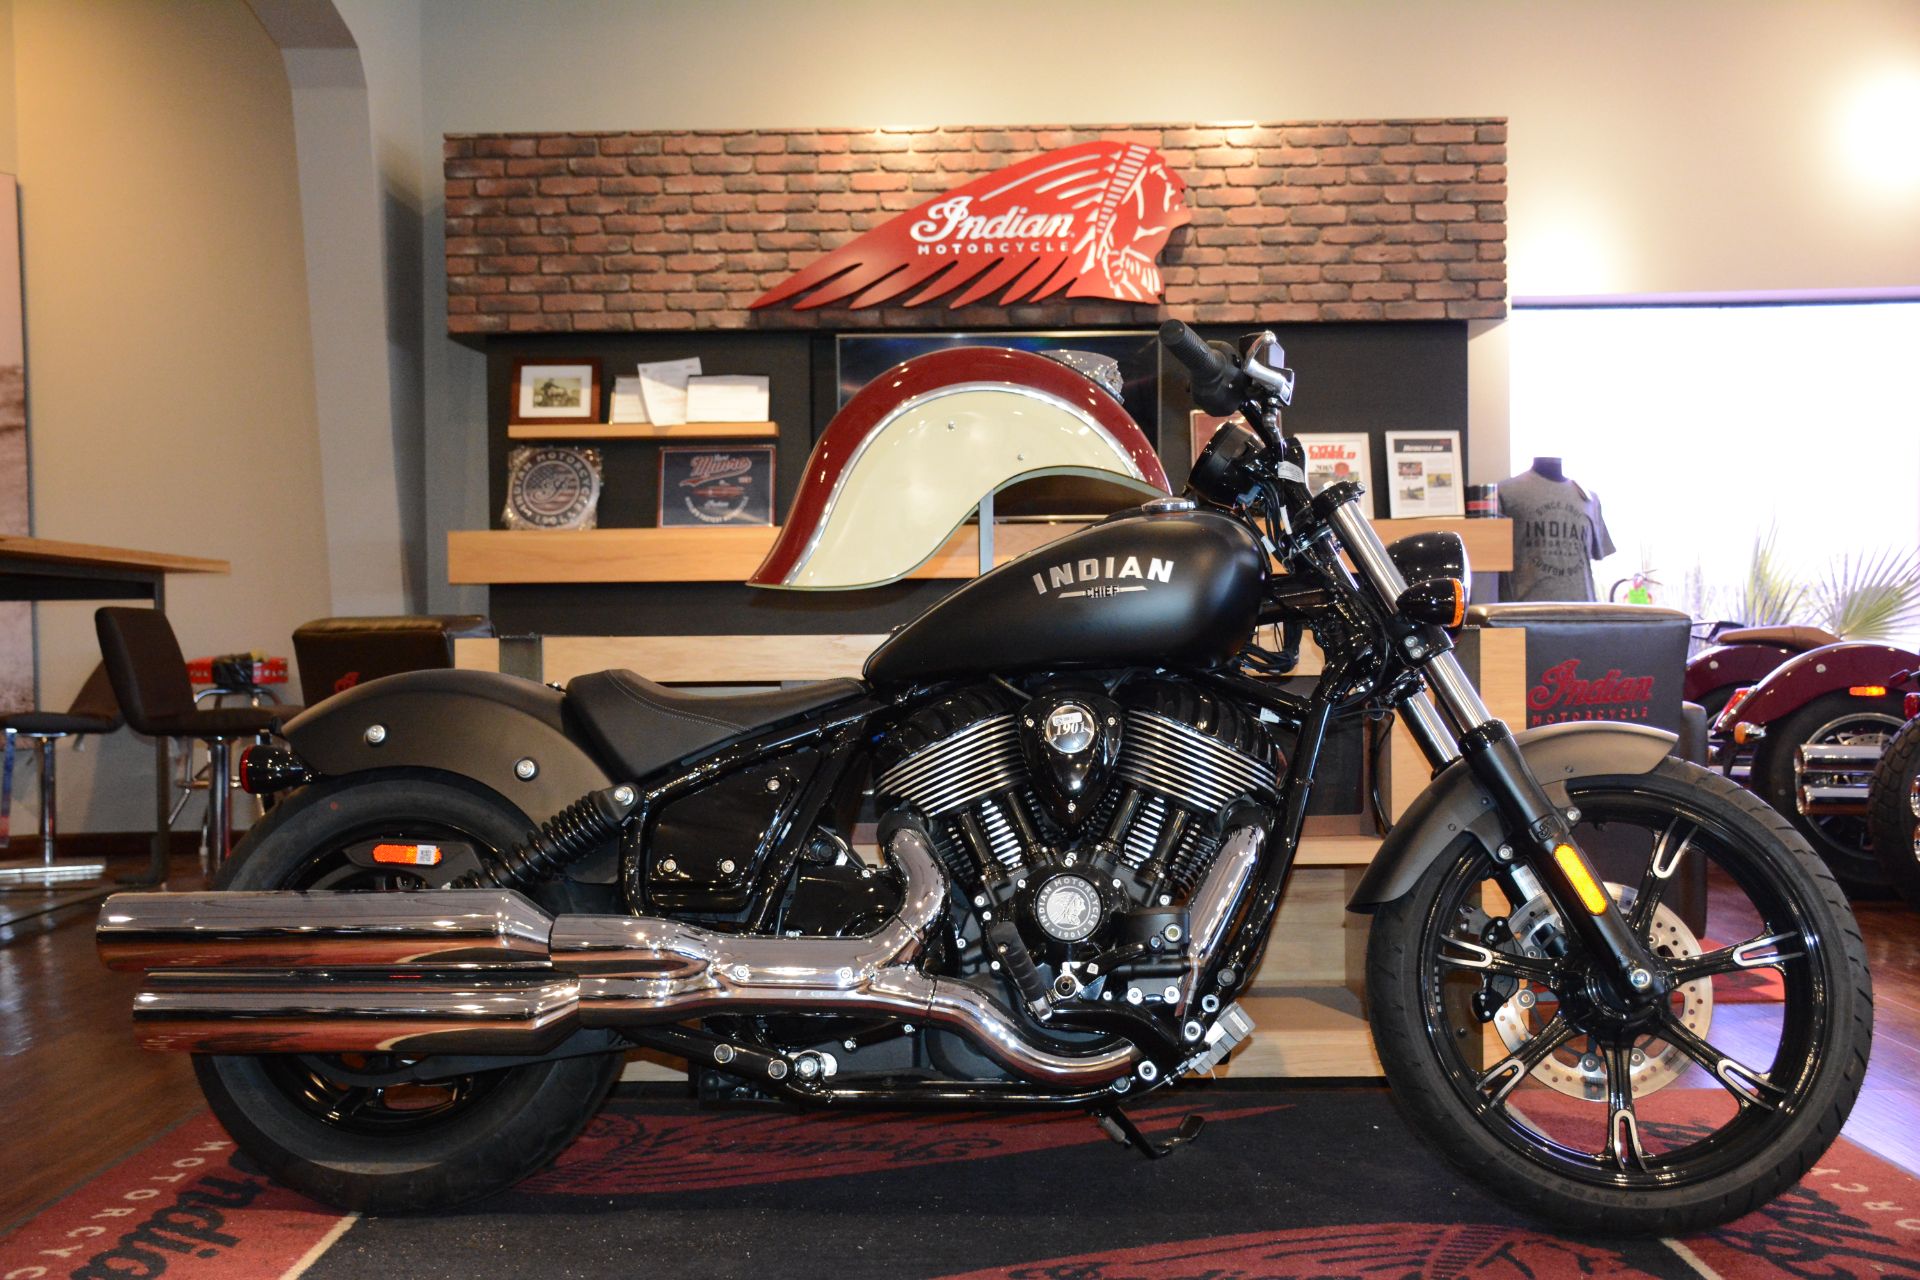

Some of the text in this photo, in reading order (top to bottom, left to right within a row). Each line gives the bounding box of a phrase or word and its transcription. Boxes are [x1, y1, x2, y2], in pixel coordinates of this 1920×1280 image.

[910, 196, 1075, 243] Indian
[917, 242, 1069, 256] MOTORCYCLE
[1032, 556, 1174, 595] INDIAN
[1085, 585, 1119, 599] CHIEF
[1526, 658, 1655, 711] Indian
[1055, 721, 1086, 736] 1901
[1531, 706, 1649, 725] MOTORCYCLE
[1038, 877, 1099, 927] INDIAN MOTORCYCLE
